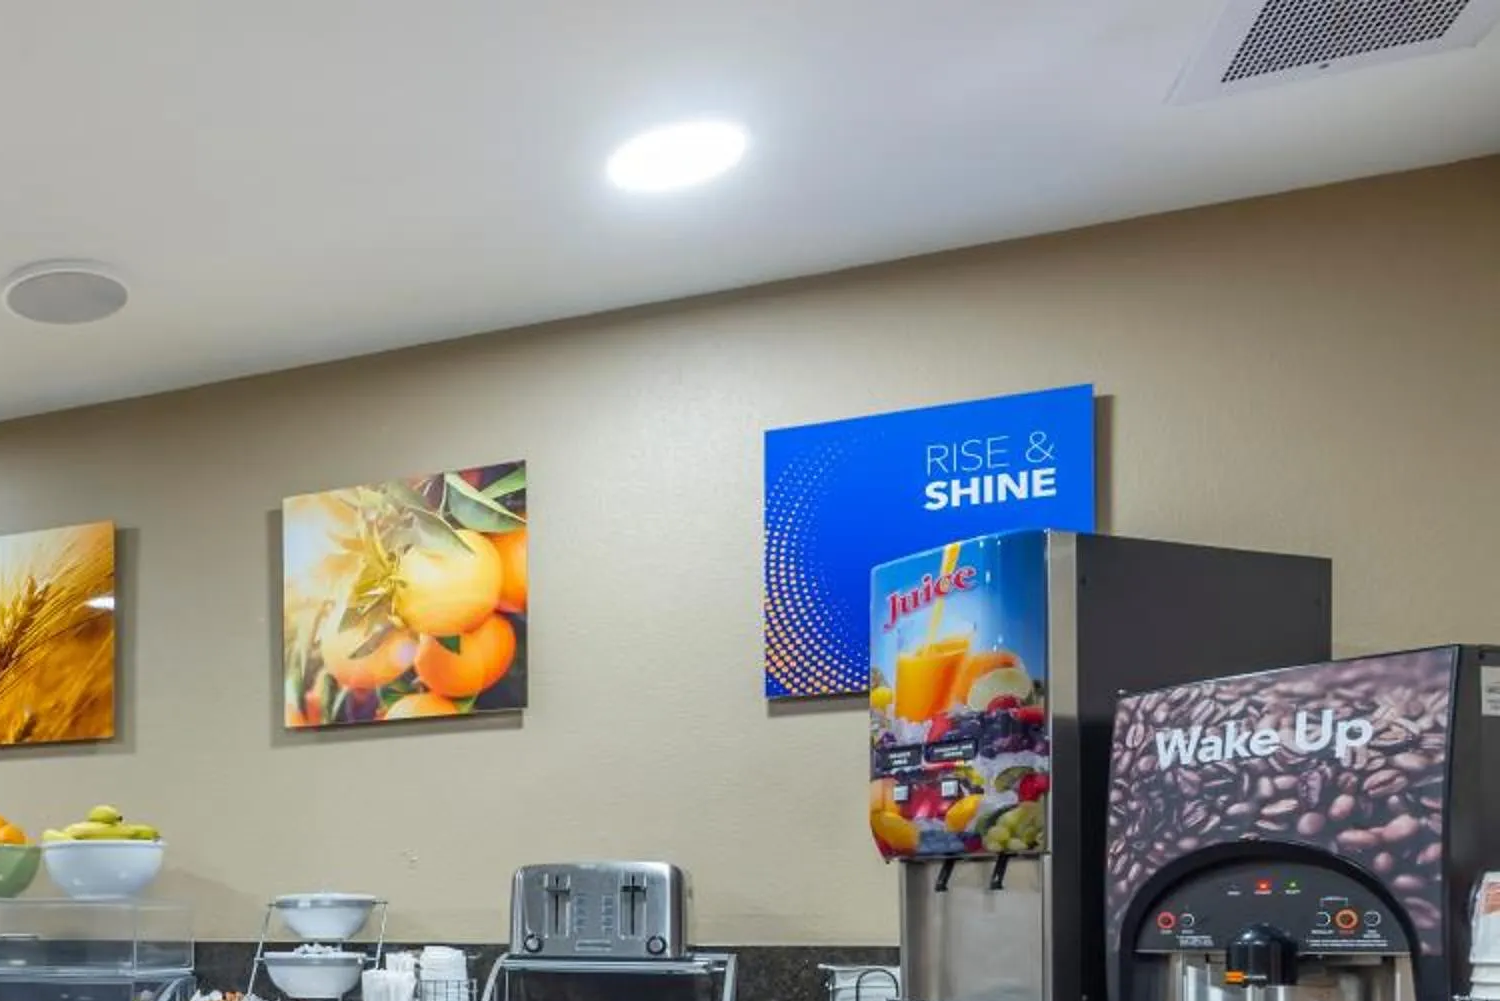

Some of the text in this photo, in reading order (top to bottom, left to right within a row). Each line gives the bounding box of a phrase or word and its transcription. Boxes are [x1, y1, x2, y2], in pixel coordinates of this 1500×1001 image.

[925, 431, 1055, 476] RISE &
[923, 468, 1057, 511] SHINE
[884, 564, 978, 631] Juice
[1155, 709, 1374, 771] Wake Up
